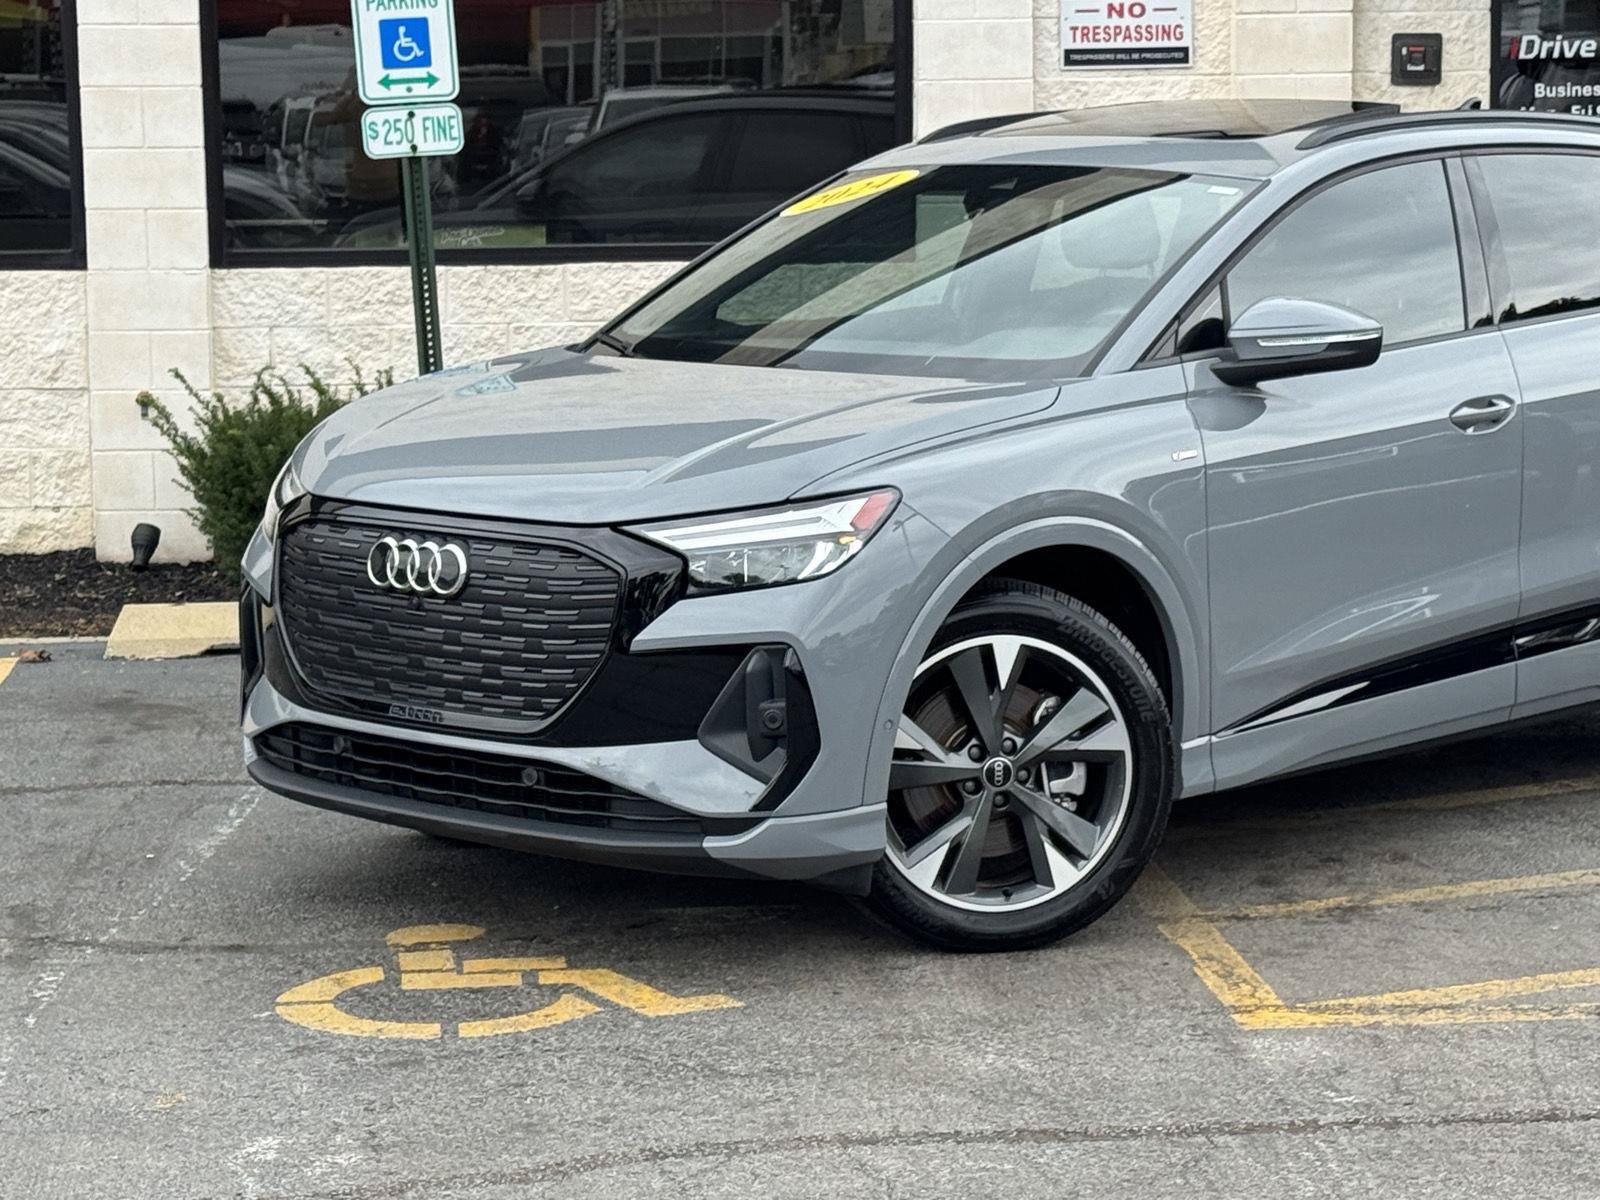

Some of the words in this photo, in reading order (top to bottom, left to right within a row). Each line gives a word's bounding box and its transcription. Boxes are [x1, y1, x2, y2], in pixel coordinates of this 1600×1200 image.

[366, 0, 438, 11] PARKING
[1107, 2, 1146, 18] NO
[1070, 24, 1184, 42] TRESPASSING
[368, 117, 415, 145] $250
[422, 116, 459, 143] FINE
